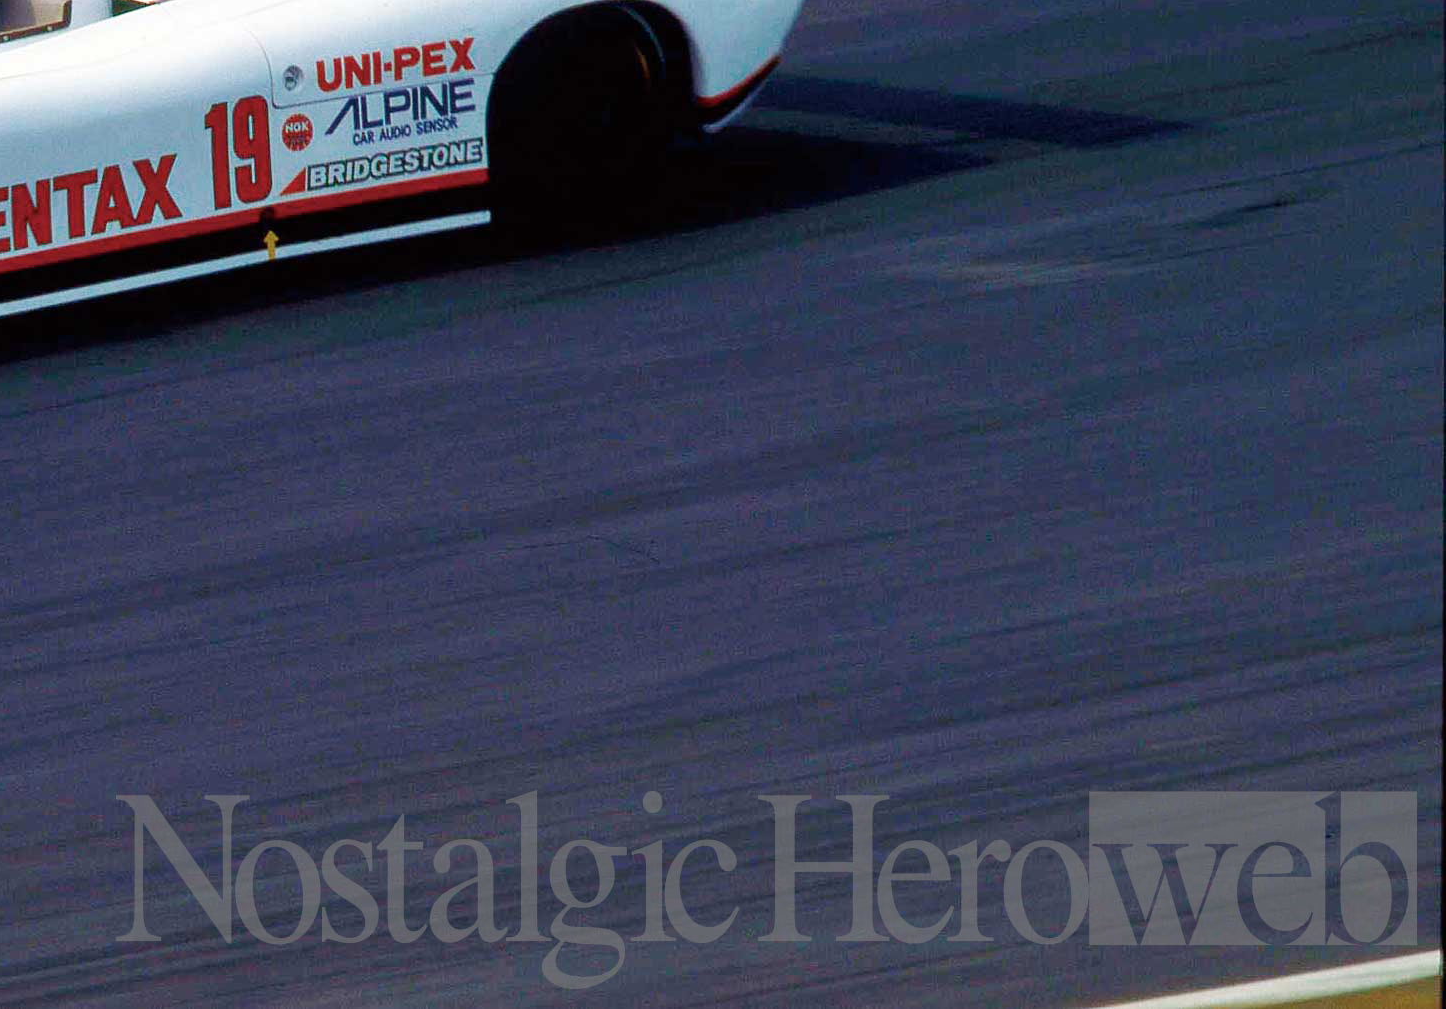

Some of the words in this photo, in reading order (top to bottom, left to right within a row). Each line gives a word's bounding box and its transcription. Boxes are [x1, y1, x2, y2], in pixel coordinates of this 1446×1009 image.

[316, 37, 476, 92] UNI-PEX
[324, 77, 476, 135] ALPINE
[353, 131, 376, 146] CAR
[380, 123, 412, 142] AUDIO
[415, 114, 459, 135] SENSOR
[204, 95, 273, 210] 19
[307, 138, 484, 190] BRIDGESTONE
